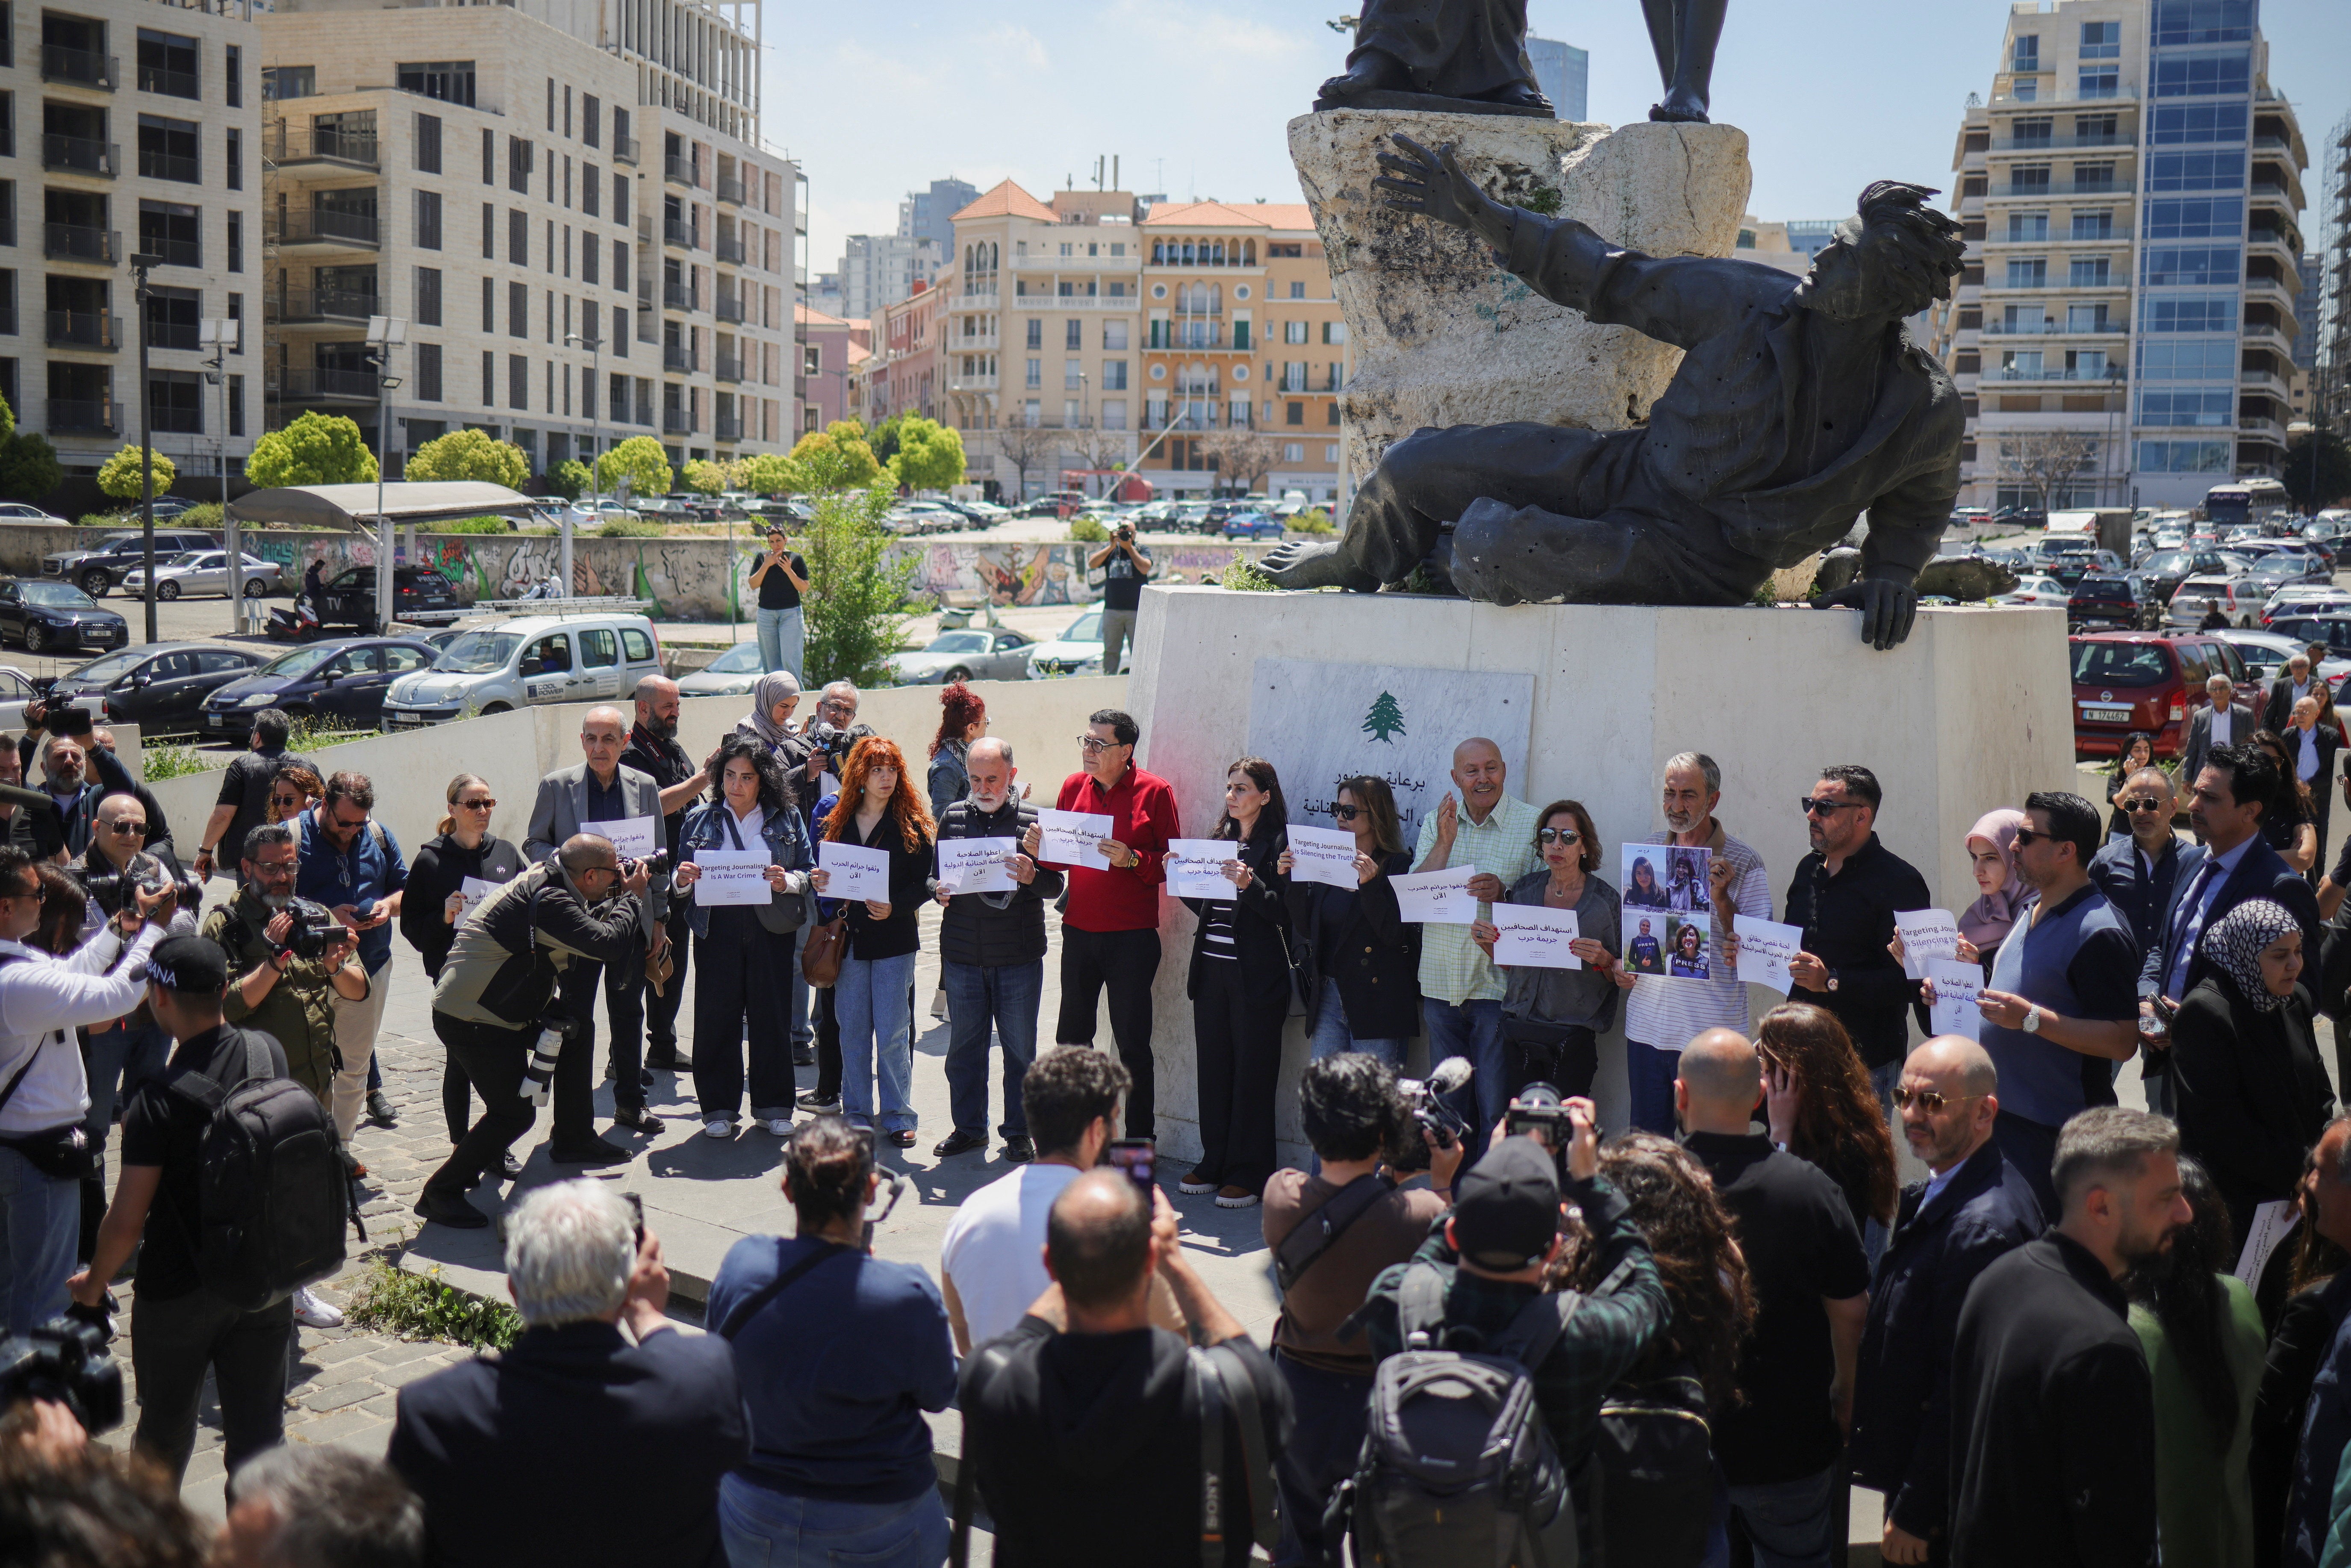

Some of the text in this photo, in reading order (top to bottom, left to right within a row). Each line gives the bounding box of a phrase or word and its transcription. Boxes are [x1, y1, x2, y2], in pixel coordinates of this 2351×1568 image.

[327, 597, 341, 610] TV
[538, 688, 563, 696] POWER
[2099, 712, 2124, 722] 174462
[647, 742, 660, 757] Canon
[630, 833, 644, 841] وثقوا
[1046, 826, 1105, 839] استهداف الصحافيين
[613, 836, 628, 844] جرائم
[1077, 836, 1093, 846] جريمة
[1294, 839, 1353, 852] Targeting Journalists
[1301, 849, 1325, 859] Silencing
[850, 862, 864, 870] جرائم
[966, 859, 987, 868] الجنائية
[1175, 857, 1205, 865] الصحافيين
[866, 864, 879, 873] وثقوا
[1204, 867, 1220, 876] جريمة
[1540, 924, 1572, 934] استهداف
[1901, 926, 1939, 937] Targeting
[1537, 934, 1557, 944] جريمة
[1747, 934, 1761, 942] حقائق
[1911, 937, 1949, 947] Silencing
[1741, 943, 1767, 955] الاسرائيلية
[1779, 940, 1790, 951] لجنة
[1768, 950, 1783, 958] الحرب
[1675, 959, 1706, 970] PRESS
[1941, 976, 1974, 989] اعطوا الصلاحية
[1934, 988, 1949, 999] الدولية
[1950, 990, 1965, 1002] الجنائية
[1206, 1471, 1218, 1530] SONY
